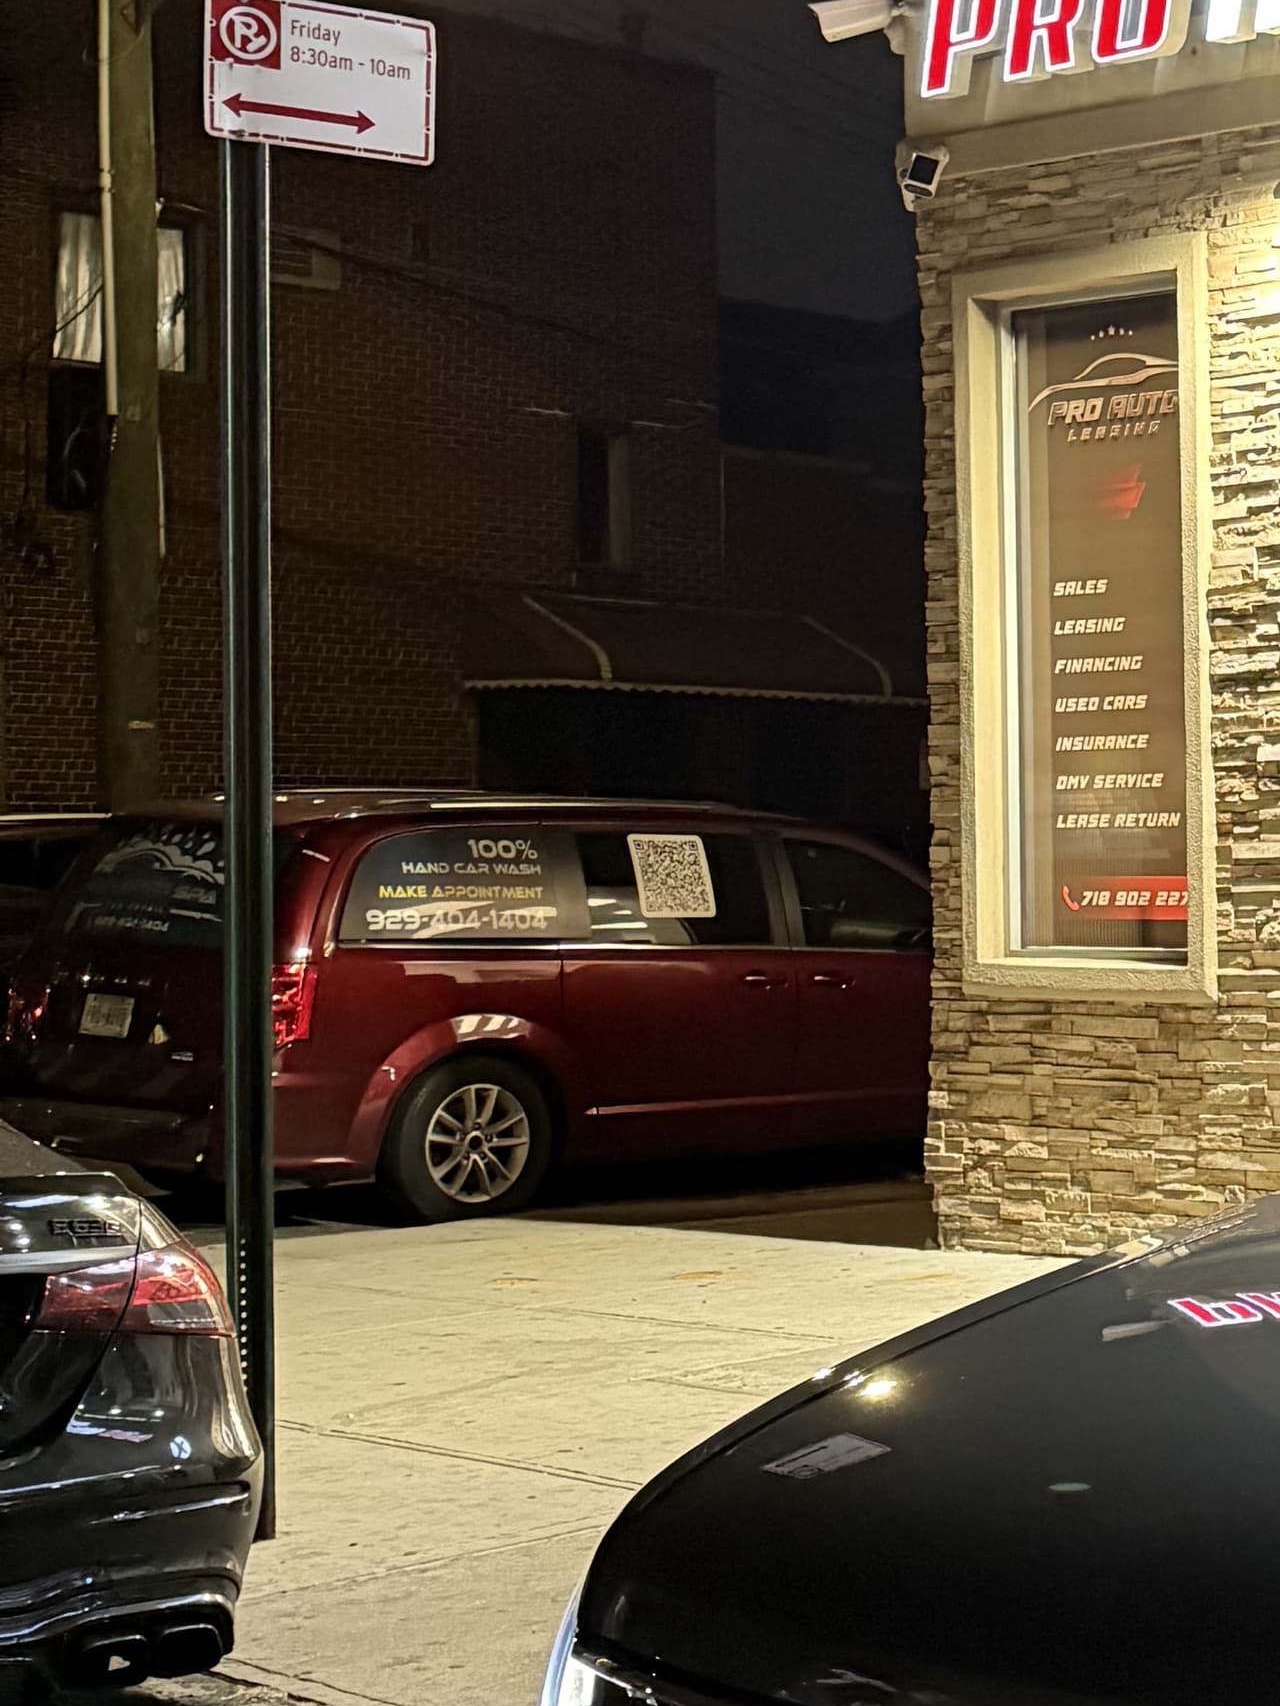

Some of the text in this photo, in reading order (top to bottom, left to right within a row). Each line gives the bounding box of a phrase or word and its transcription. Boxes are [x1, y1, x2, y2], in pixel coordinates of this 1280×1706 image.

[290, 19, 341, 46] Friday
[290, 46, 353, 71] 8:30am
[370, 58, 411, 80] 10am
[1048, 389, 1178, 425] PRO AUTO
[1067, 420, 1161, 442] LEASING
[1053, 579, 1108, 597] SALES
[1054, 617, 1126, 635] LEASING
[1054, 655, 1143, 674] FINANCING
[1055, 694, 1148, 713] USED CARS
[1055, 734, 1149, 752] INSURANCE
[1056, 773, 1164, 790] DMV SERVICE
[1056, 812, 1181, 829] LEASE RETURN
[467, 839, 538, 860] 100%
[402, 862, 541, 876] HAND CAR WASH
[379, 885, 544, 899] MAKE APPOINTMENT
[1081, 891, 1111, 906] 718
[1114, 891, 1150, 906] 902
[366, 911, 548, 932] 929-404-1404
